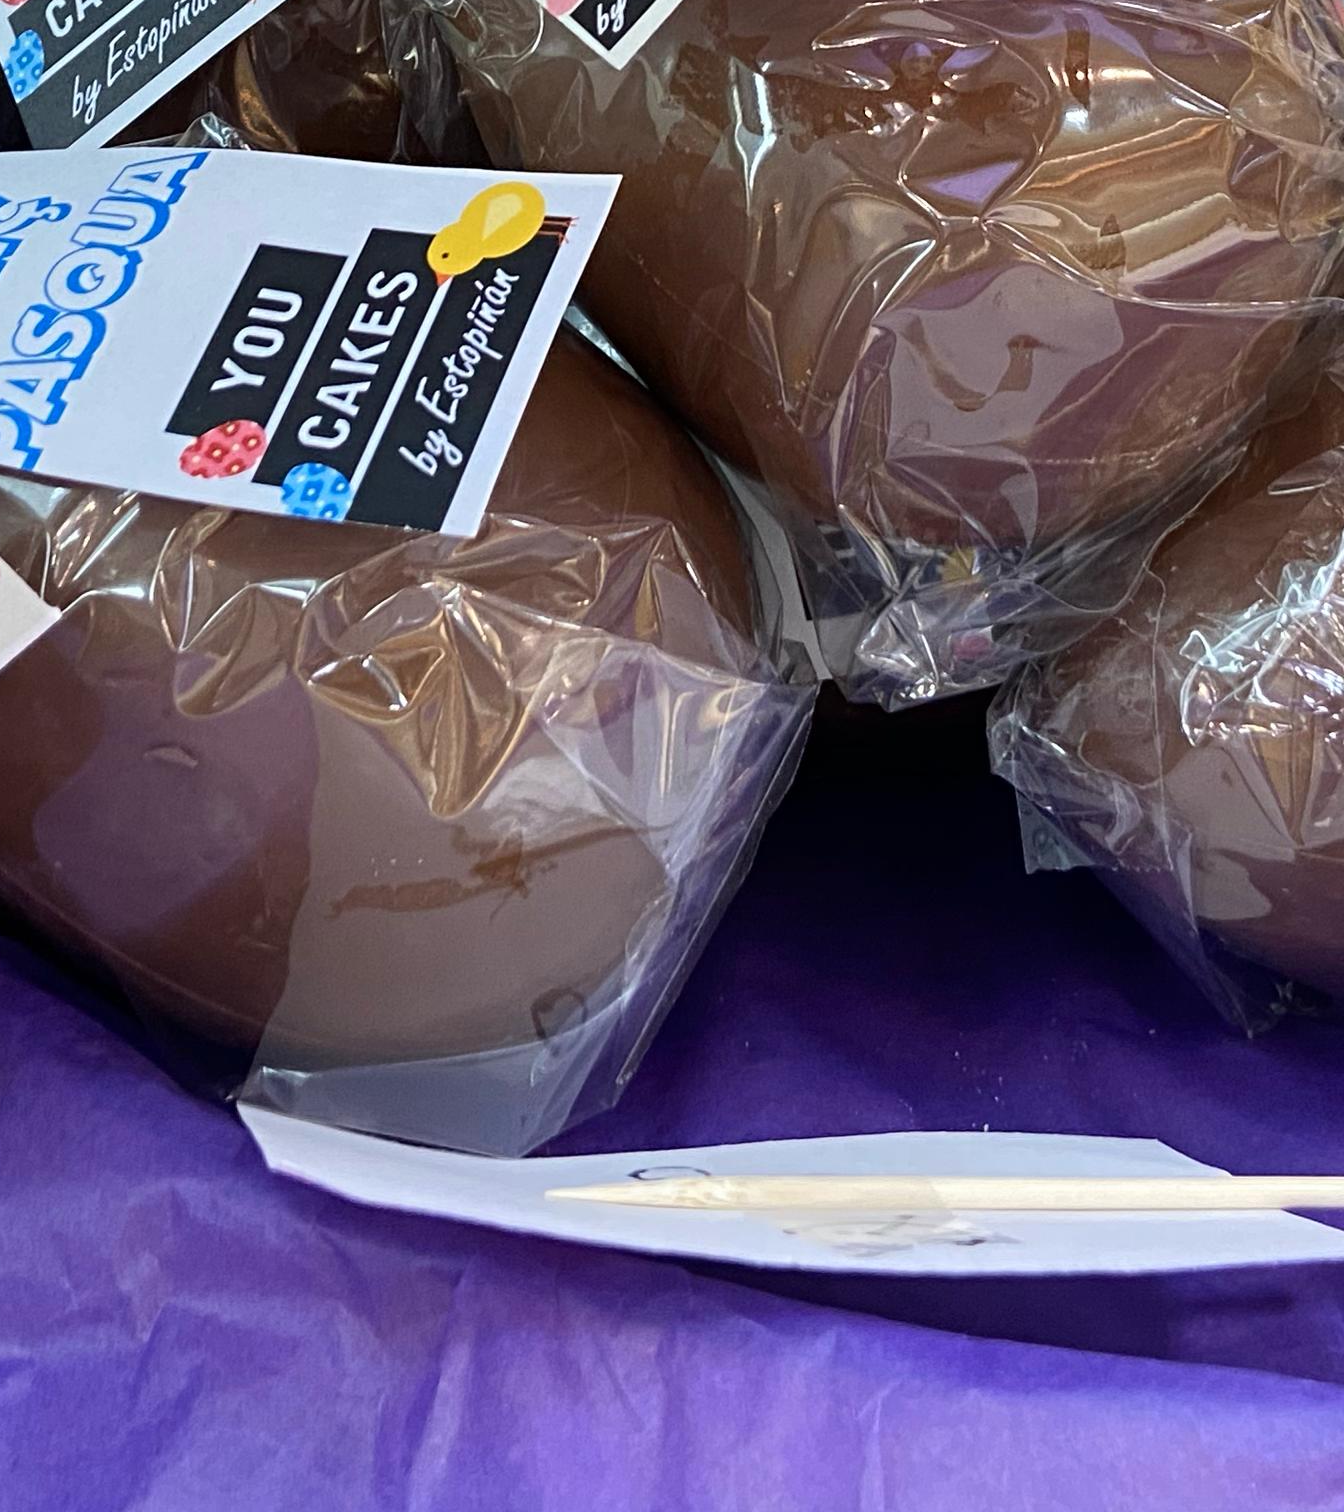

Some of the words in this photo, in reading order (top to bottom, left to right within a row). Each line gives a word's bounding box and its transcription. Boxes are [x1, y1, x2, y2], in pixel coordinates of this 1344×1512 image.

[70, 73, 102, 125] by
[212, 286, 303, 397] YOU
[297, 266, 418, 452] CAKES
[413, 265, 521, 429] Estopiñán
[397, 428, 461, 478] by
